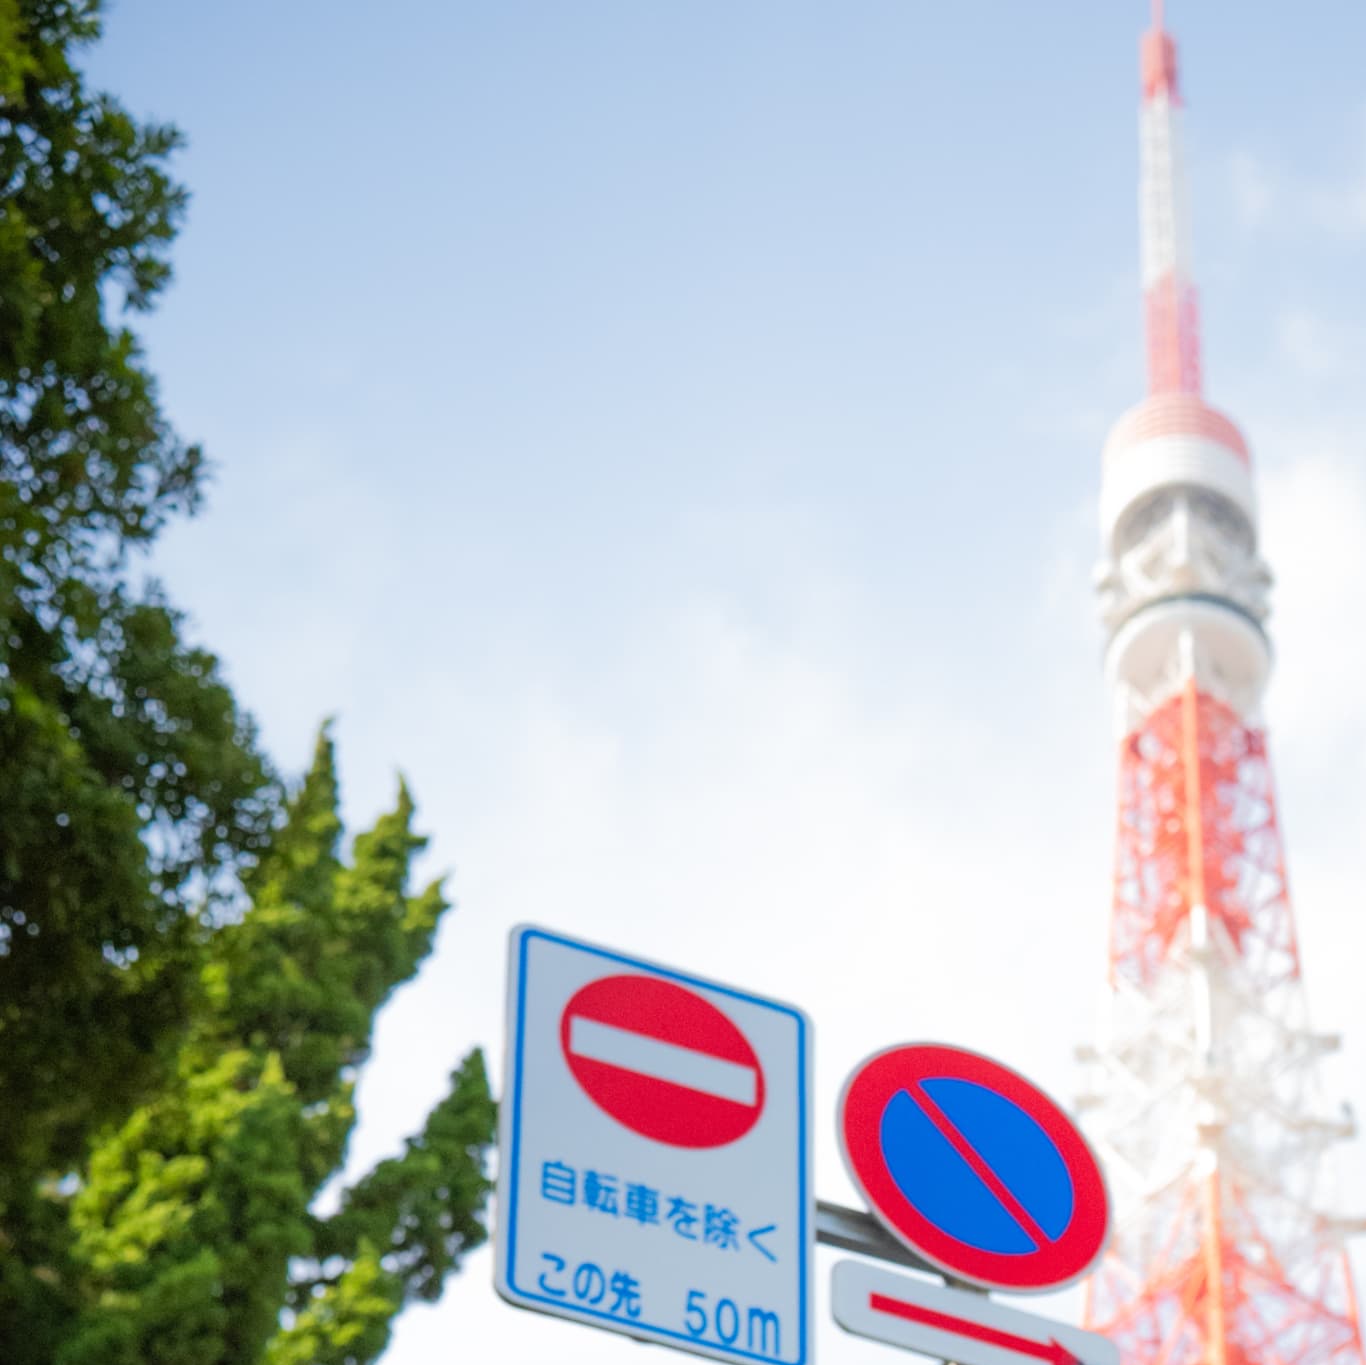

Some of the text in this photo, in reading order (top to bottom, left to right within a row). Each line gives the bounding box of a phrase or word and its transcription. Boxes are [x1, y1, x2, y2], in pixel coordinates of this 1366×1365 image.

[540, 1160, 778, 1263] 自転車を除く
[537, 1251, 781, 1357] この先 50m
